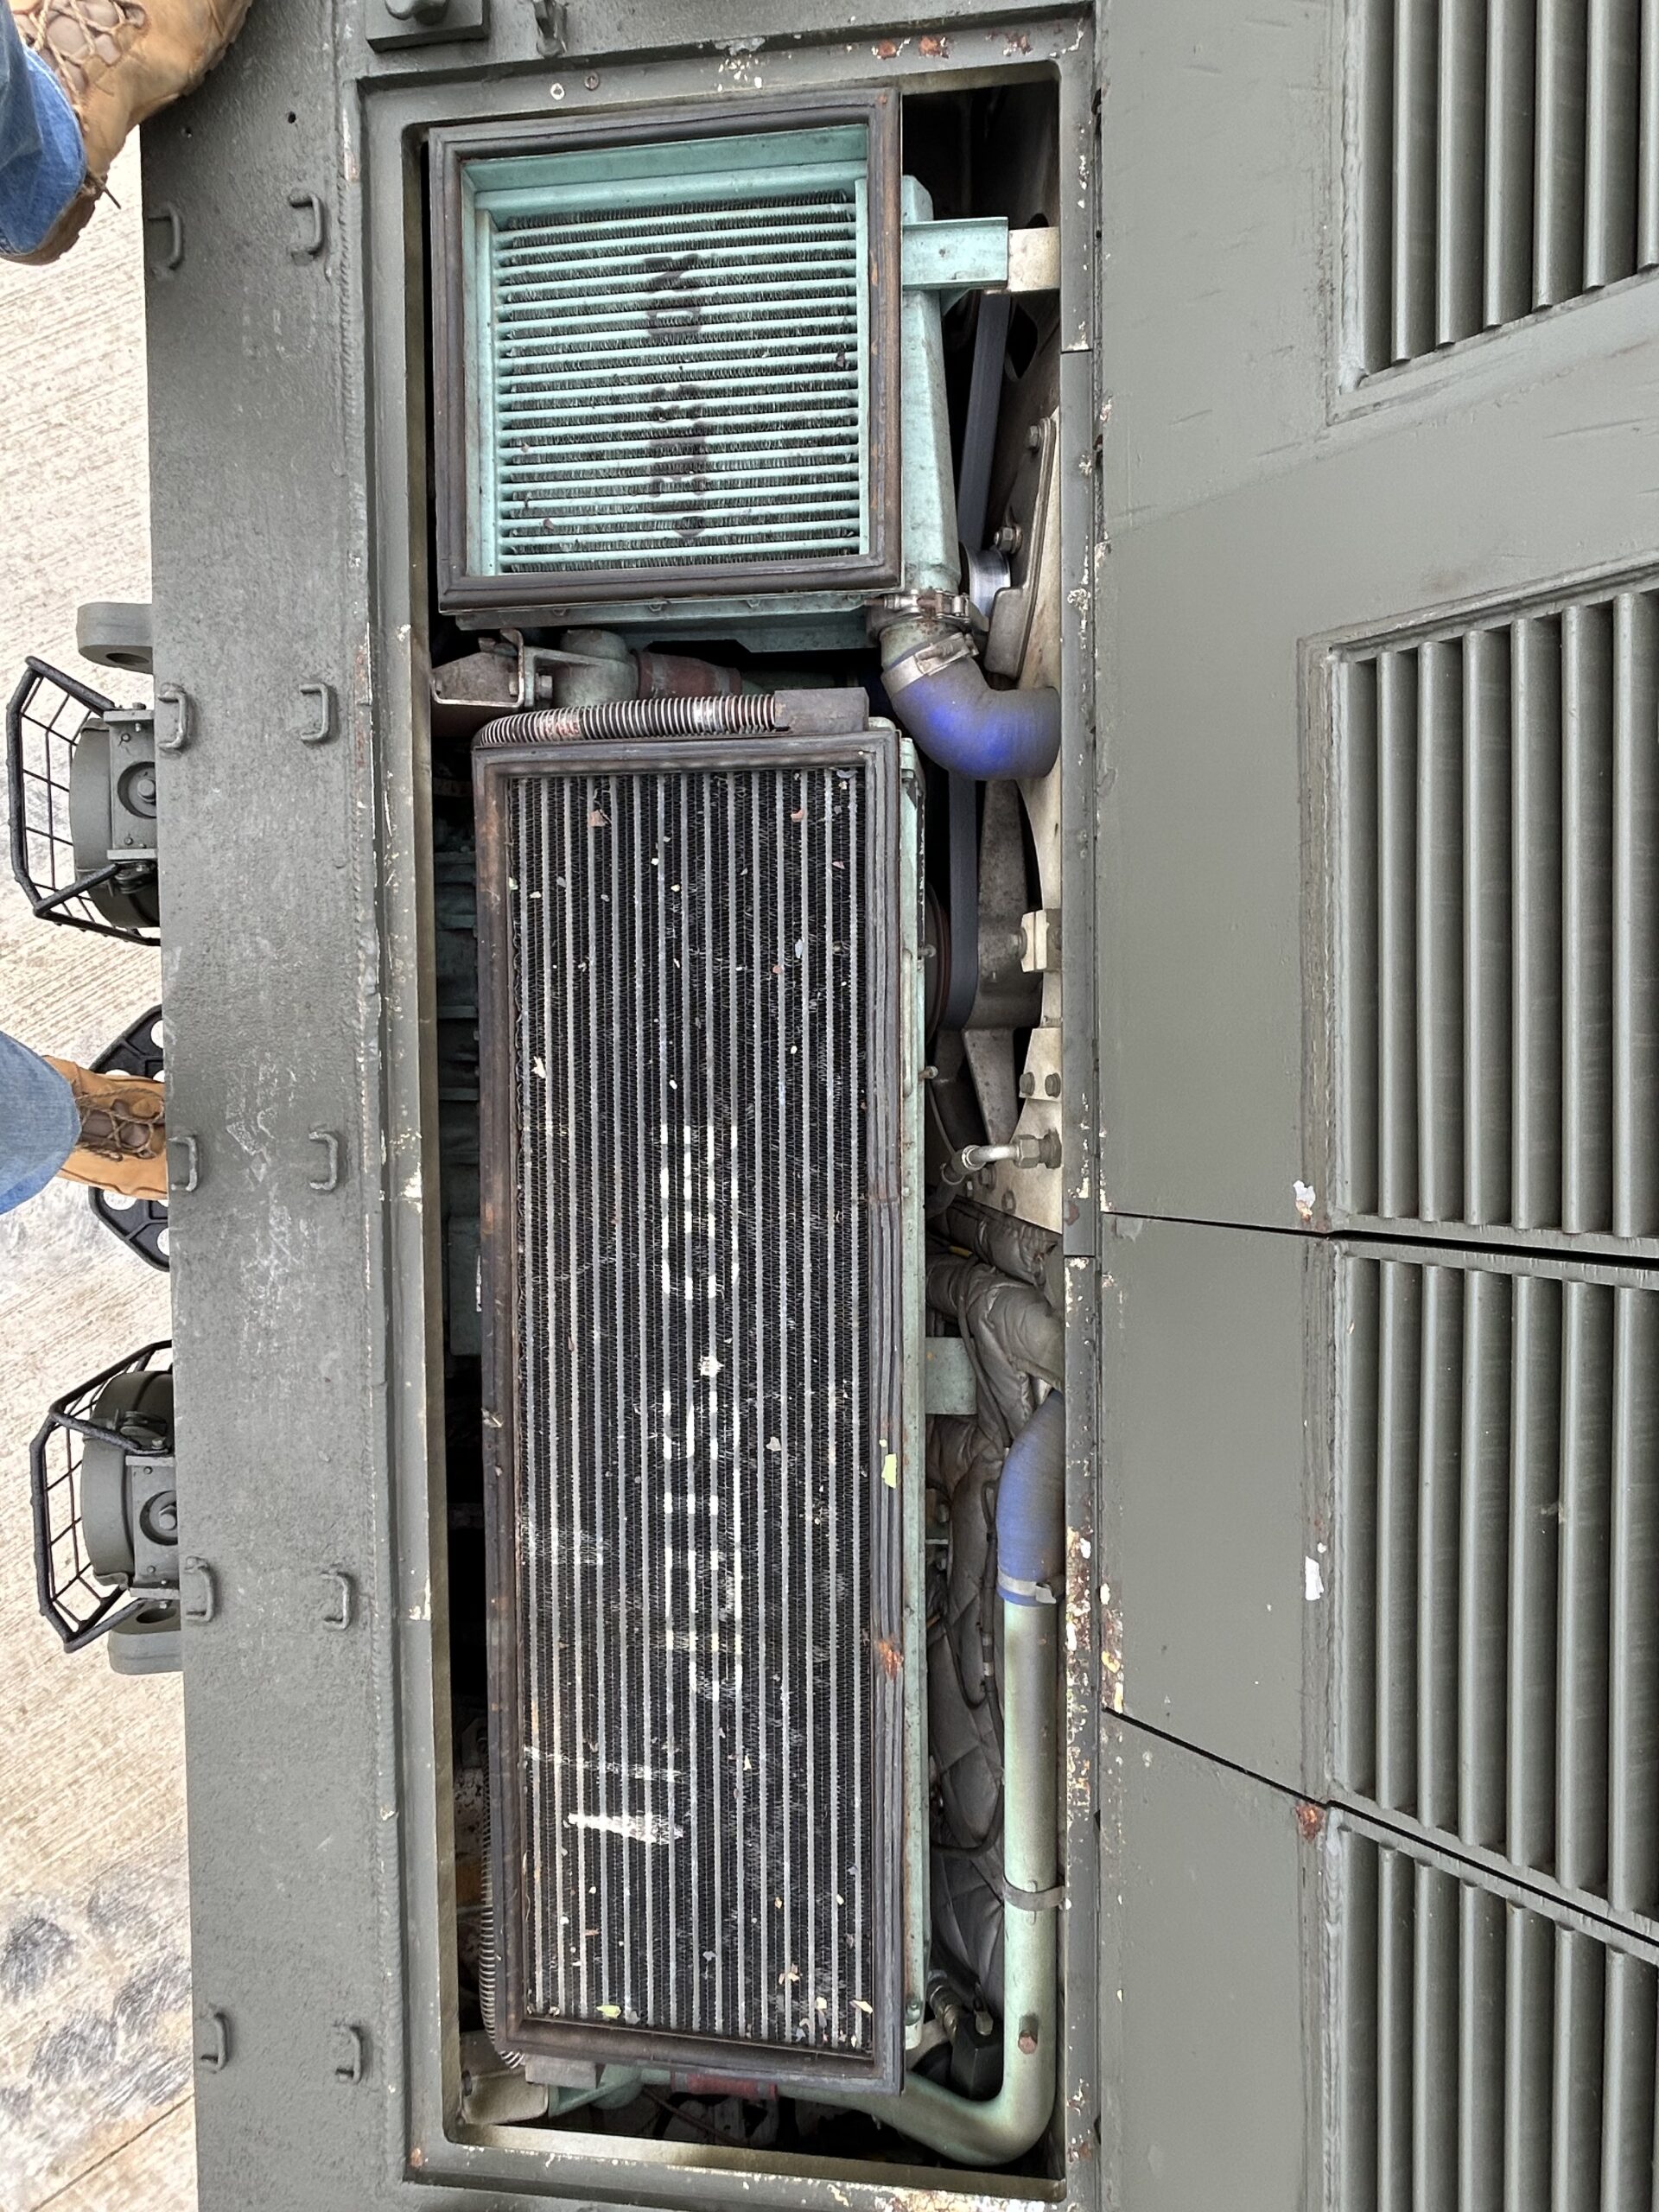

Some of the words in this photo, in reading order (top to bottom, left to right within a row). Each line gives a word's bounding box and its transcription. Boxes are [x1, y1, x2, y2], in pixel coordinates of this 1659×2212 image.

[646, 254, 703, 335] NO
[649, 385, 709, 537] STEP
[661, 1125, 740, 1300] NO
[664, 1389, 743, 1701] STEP
